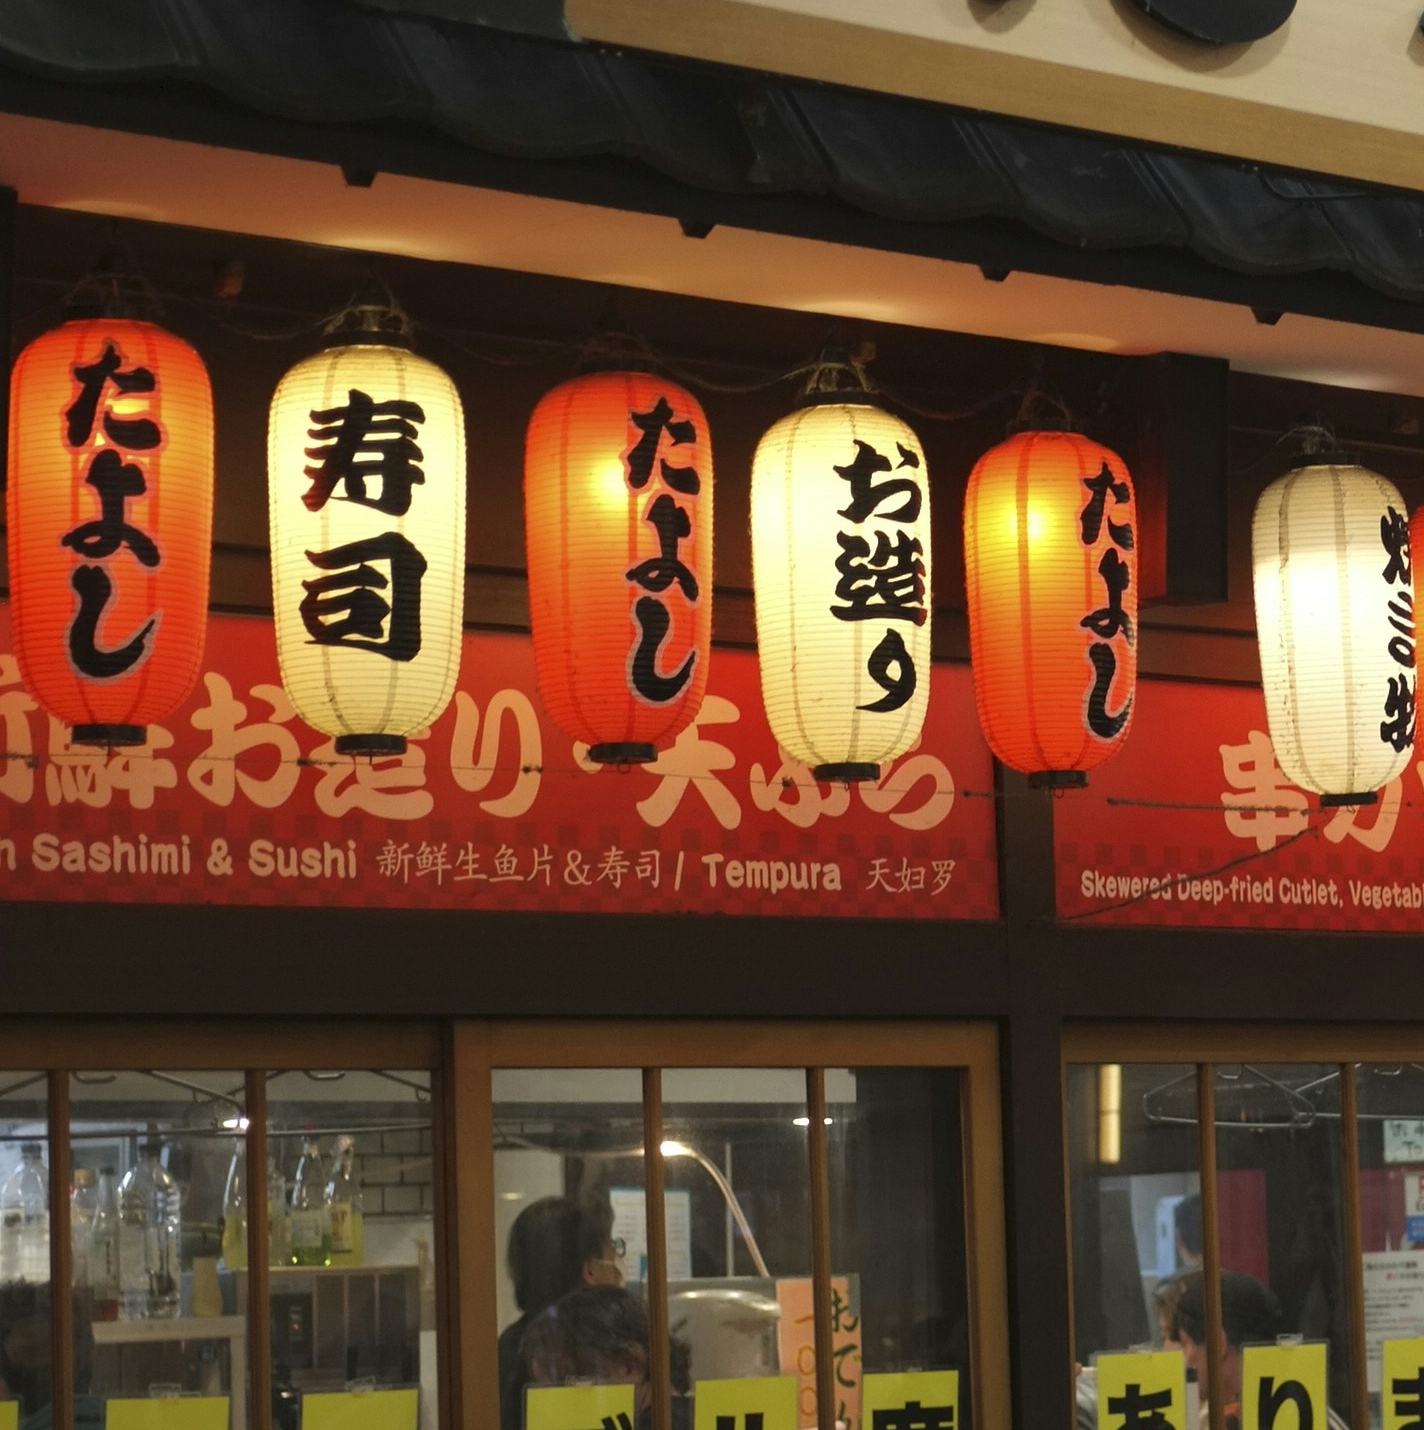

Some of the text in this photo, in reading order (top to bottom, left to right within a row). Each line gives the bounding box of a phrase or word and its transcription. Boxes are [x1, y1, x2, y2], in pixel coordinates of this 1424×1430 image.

[62, 340, 162, 681] たよし
[301, 389, 428, 663] 寿司
[626, 397, 700, 702] たよし
[829, 439, 928, 713] お造り
[1081, 461, 1136, 739] たよし
[32, 833, 191, 876] Sashimi
[207, 837, 234, 877] &
[249, 839, 357, 879] Sushi
[701, 853, 841, 895] Tempura
[1081, 870, 1172, 902] Skewered
[1177, 874, 1274, 905] Deep-fried
[1278, 877, 1344, 908] Cutlet,
